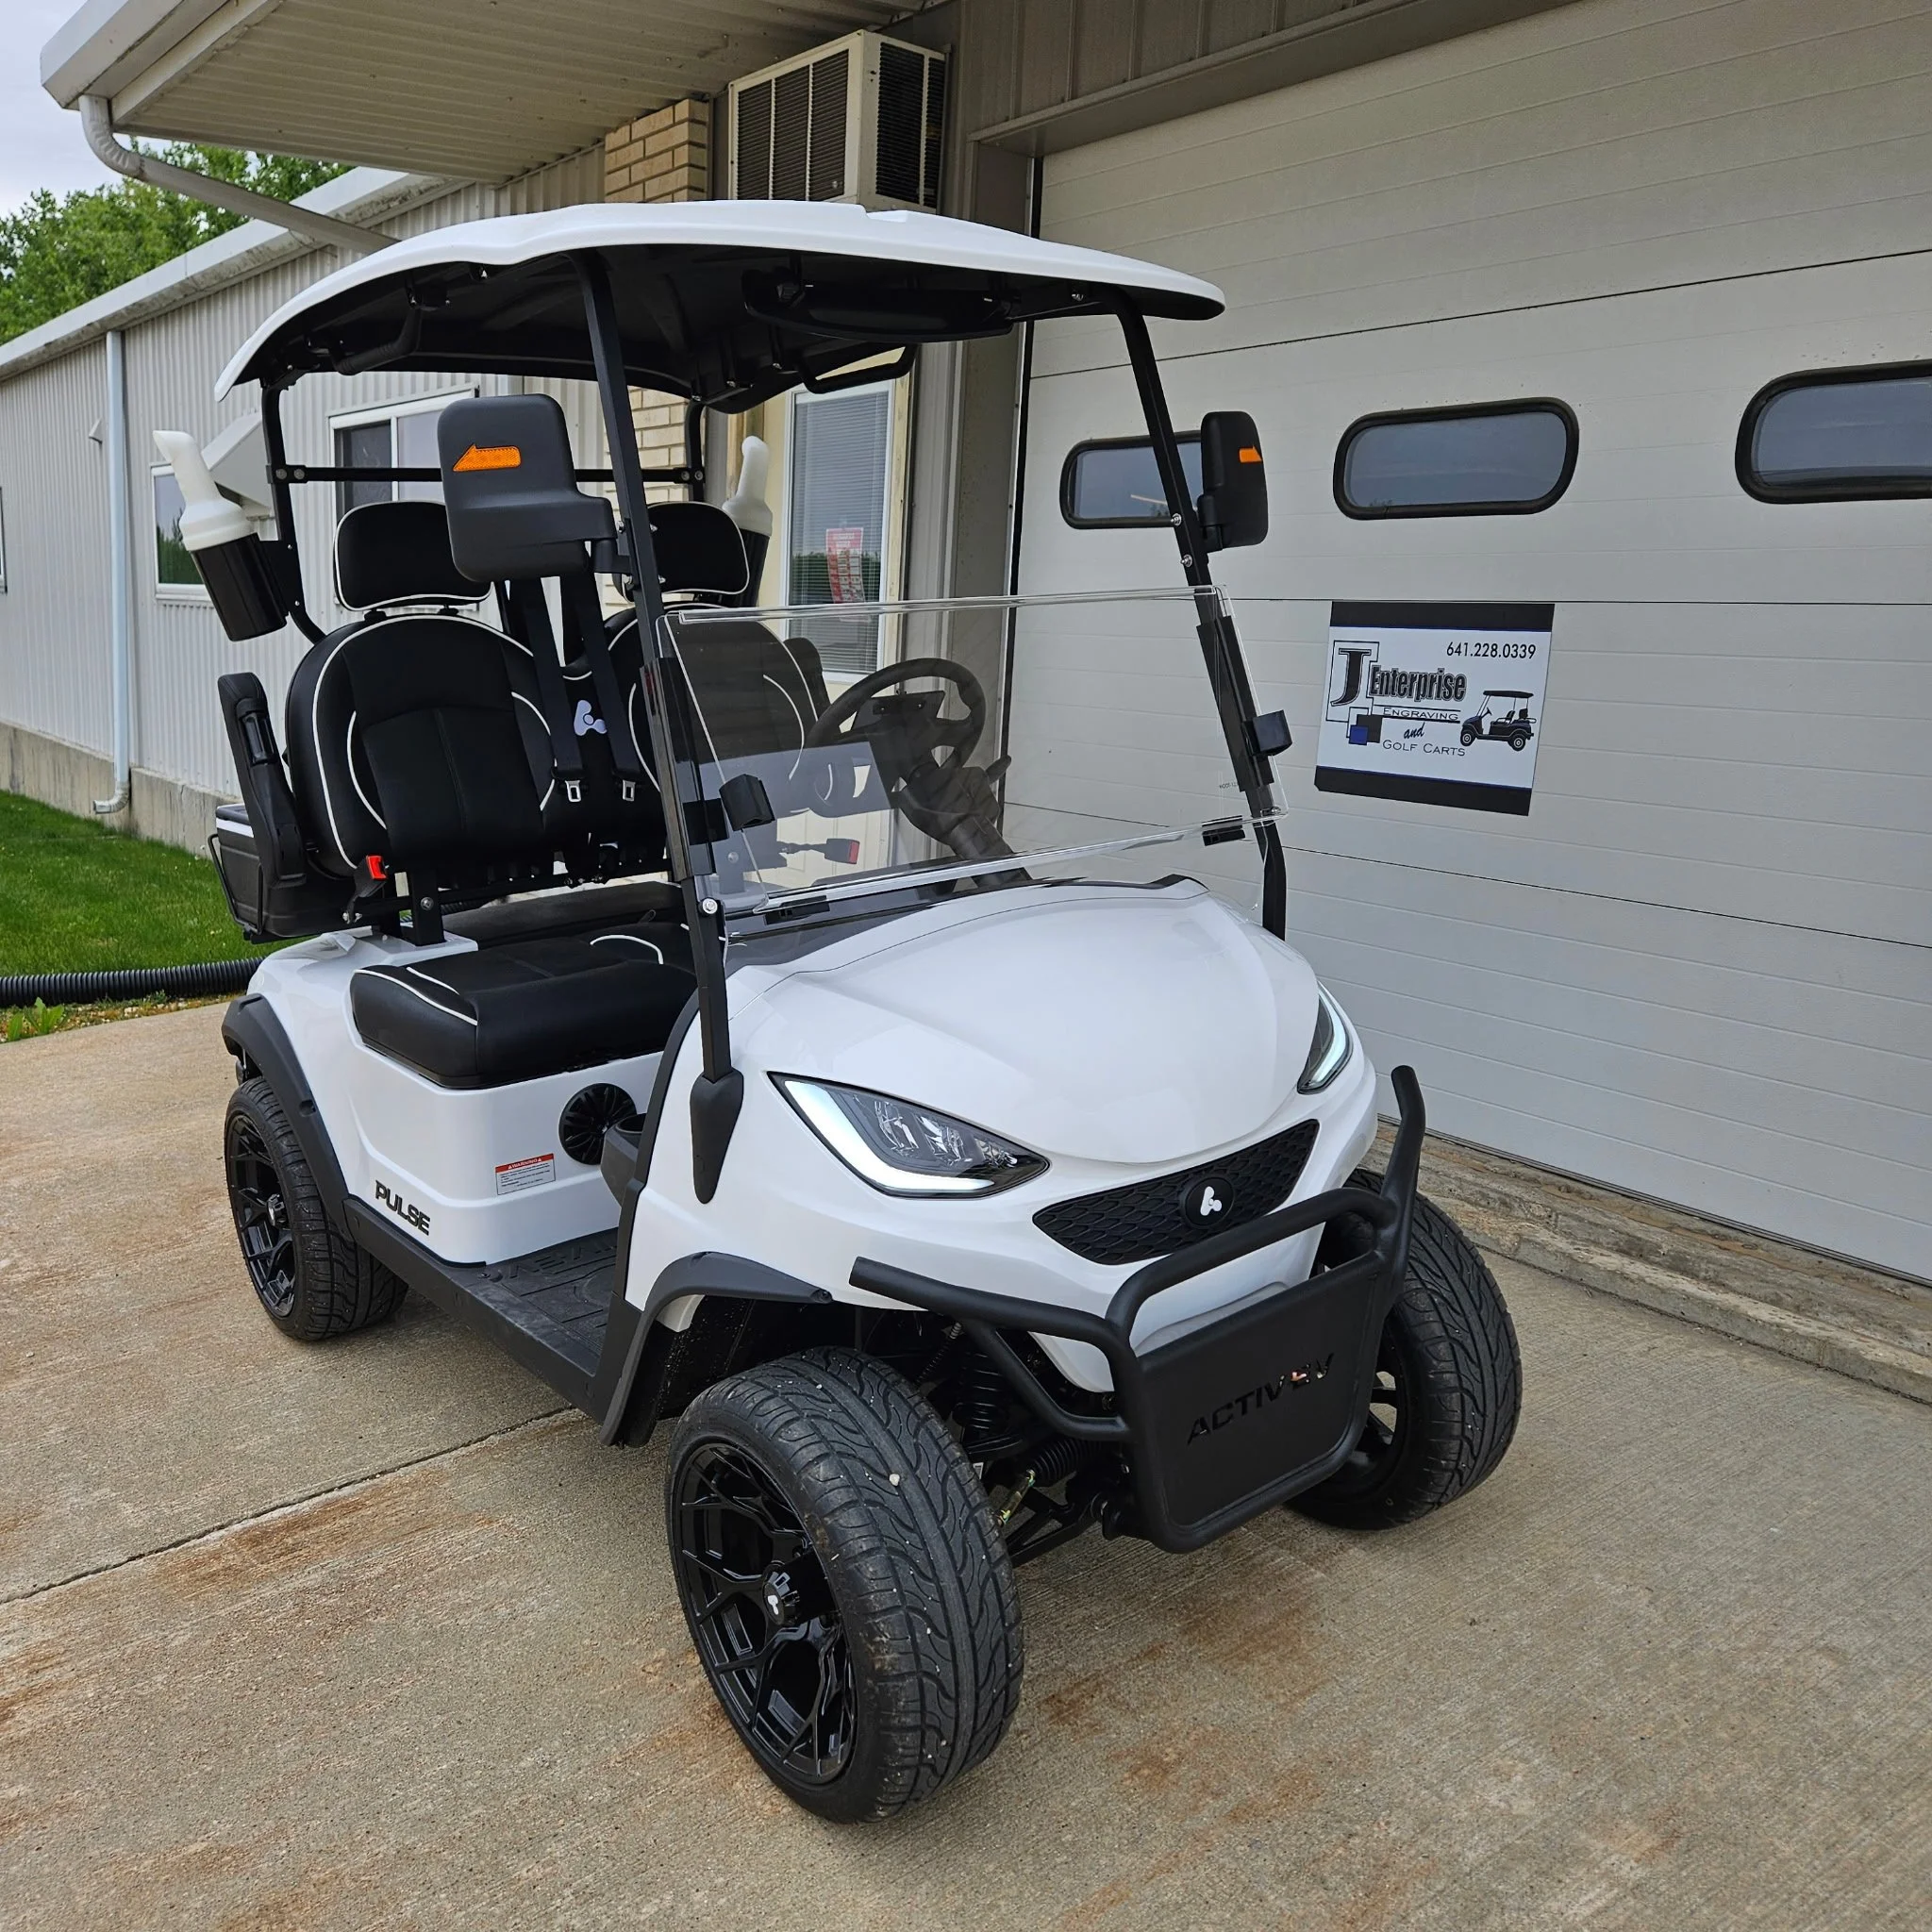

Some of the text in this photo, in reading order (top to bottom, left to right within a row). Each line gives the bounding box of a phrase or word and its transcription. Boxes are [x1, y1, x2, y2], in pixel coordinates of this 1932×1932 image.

[1446, 641, 1537, 659] 641.228.0339
[1330, 648, 1468, 707] J Enterprise
[1383, 707, 1458, 721] ENGRAVING
[1403, 722, 1425, 740] and
[1382, 740, 1466, 757] GOLF CARTS
[512, 1159, 538, 1168] WARNING
[375, 1179, 430, 1236] PULSE
